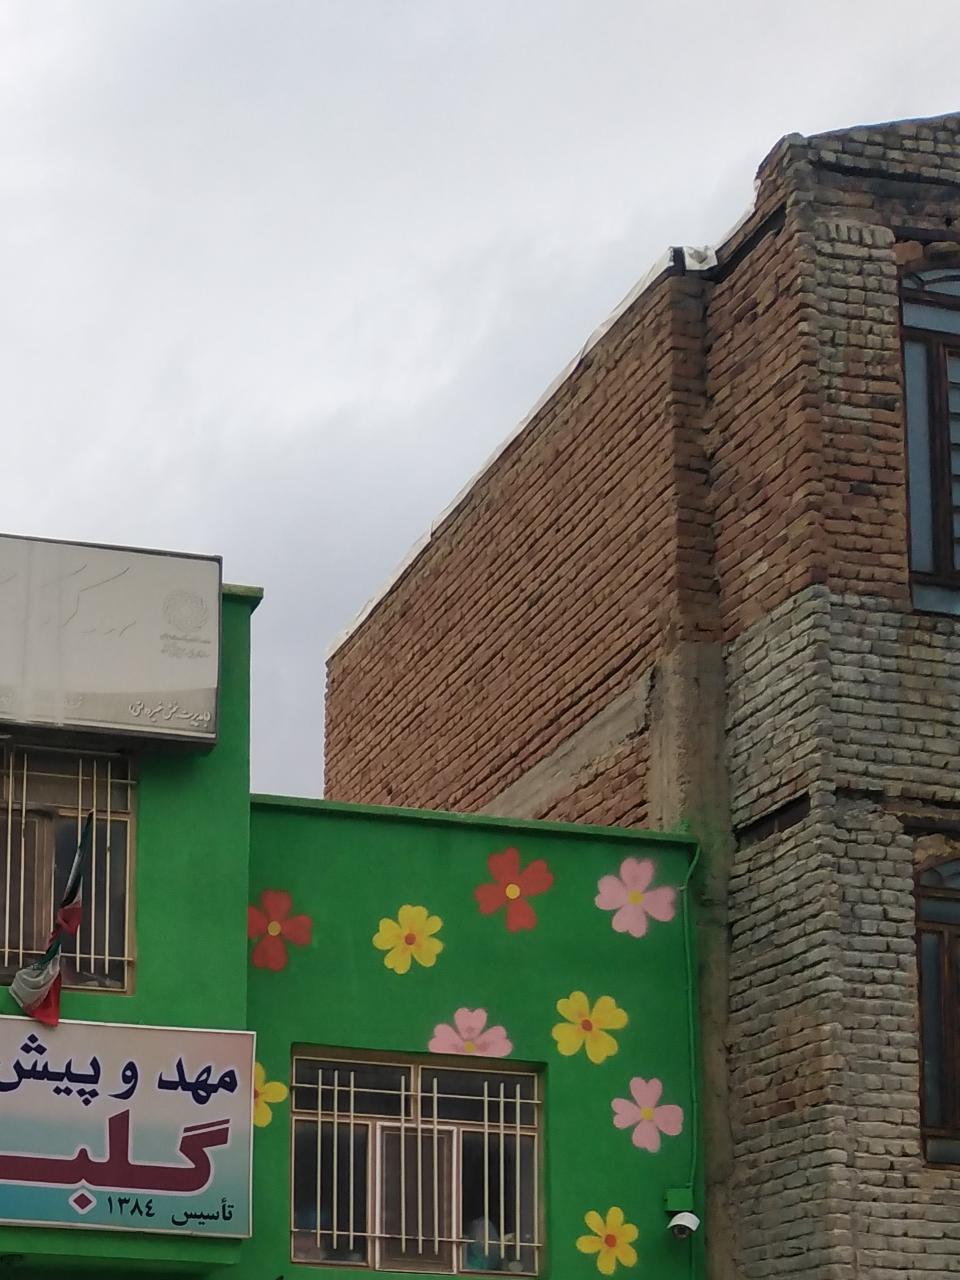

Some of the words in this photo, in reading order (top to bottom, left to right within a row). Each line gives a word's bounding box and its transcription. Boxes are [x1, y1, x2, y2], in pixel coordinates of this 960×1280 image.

[107, 1061, 140, 1099] و
[157, 1056, 239, 1106] مهد
[171, 1197, 235, 1226] تأسیس
